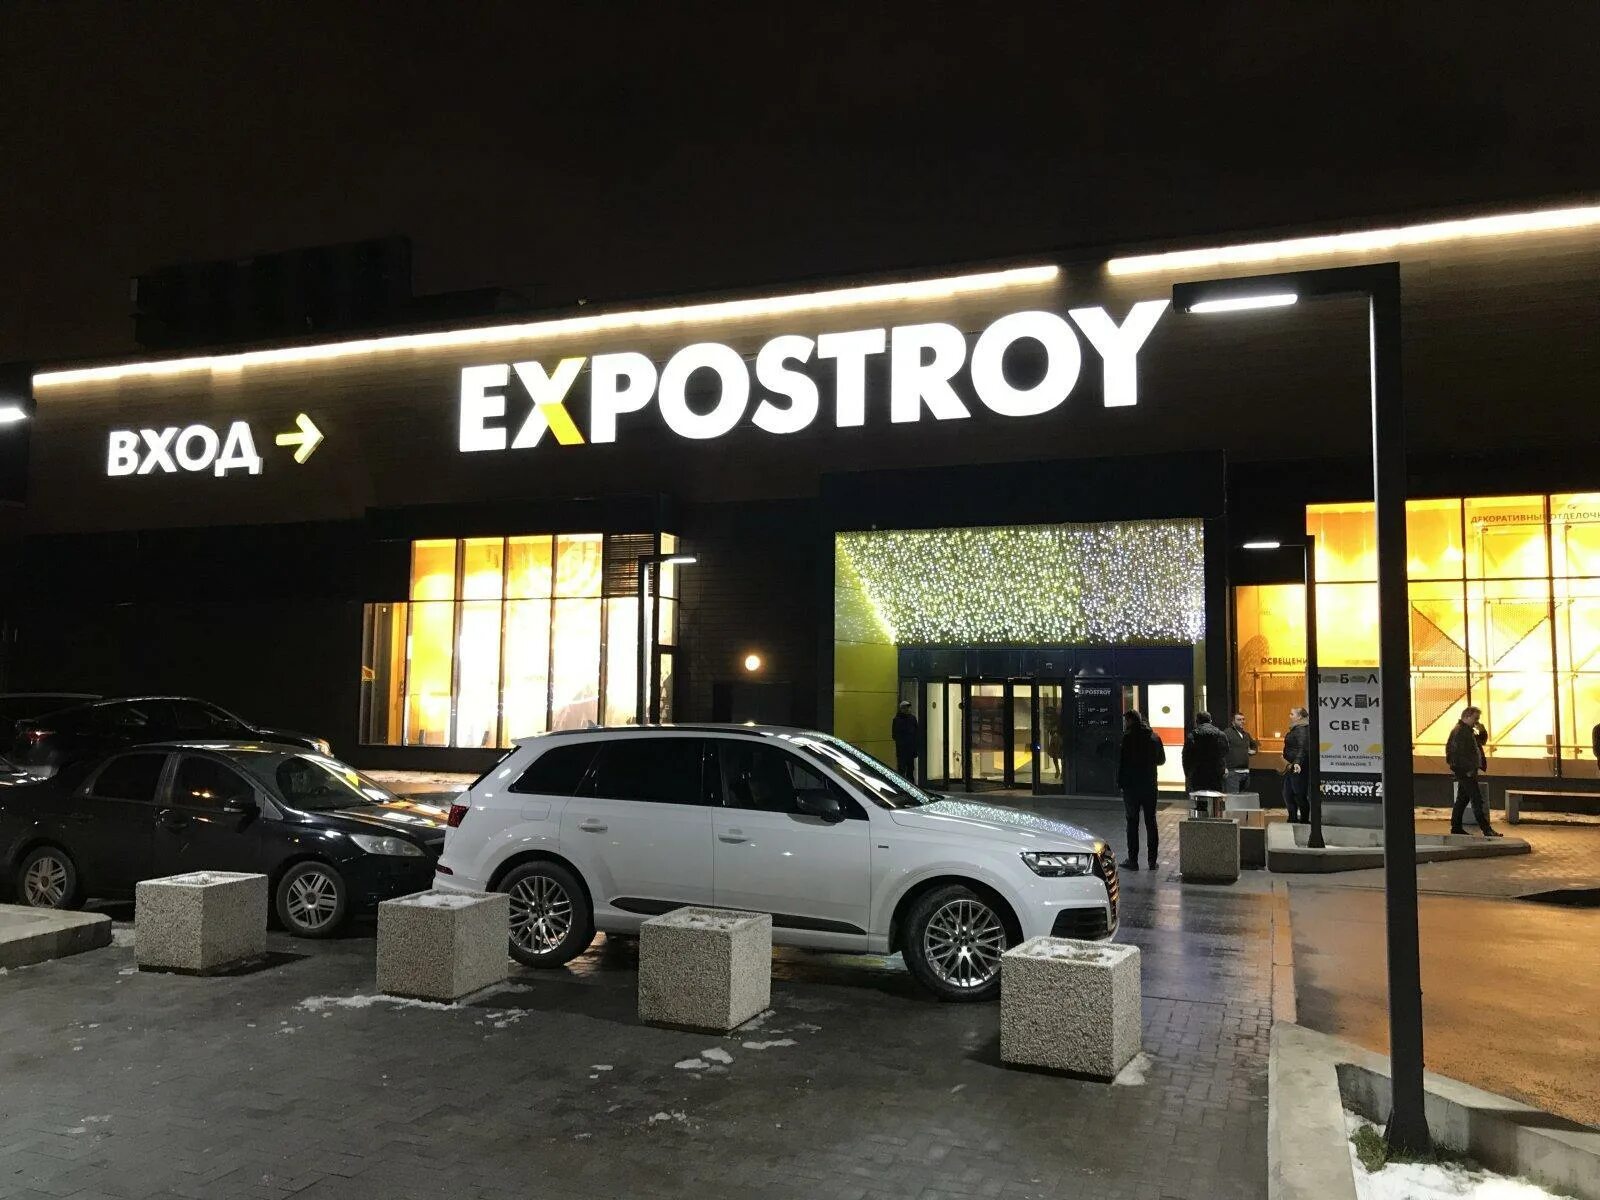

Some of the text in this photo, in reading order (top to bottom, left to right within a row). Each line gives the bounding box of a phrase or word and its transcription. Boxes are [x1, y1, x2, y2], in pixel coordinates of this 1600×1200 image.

[459, 299, 1171, 453] EXPOSTROY
[107, 420, 263, 477] ВХОД
[1471, 514, 1546, 524] ДЕКОРАТИВНЫ
[1261, 657, 1308, 666] ОСВЕЩЕНИ
[1342, 743, 1359, 752] 100
[1319, 784, 1374, 793] XPOSTROY
